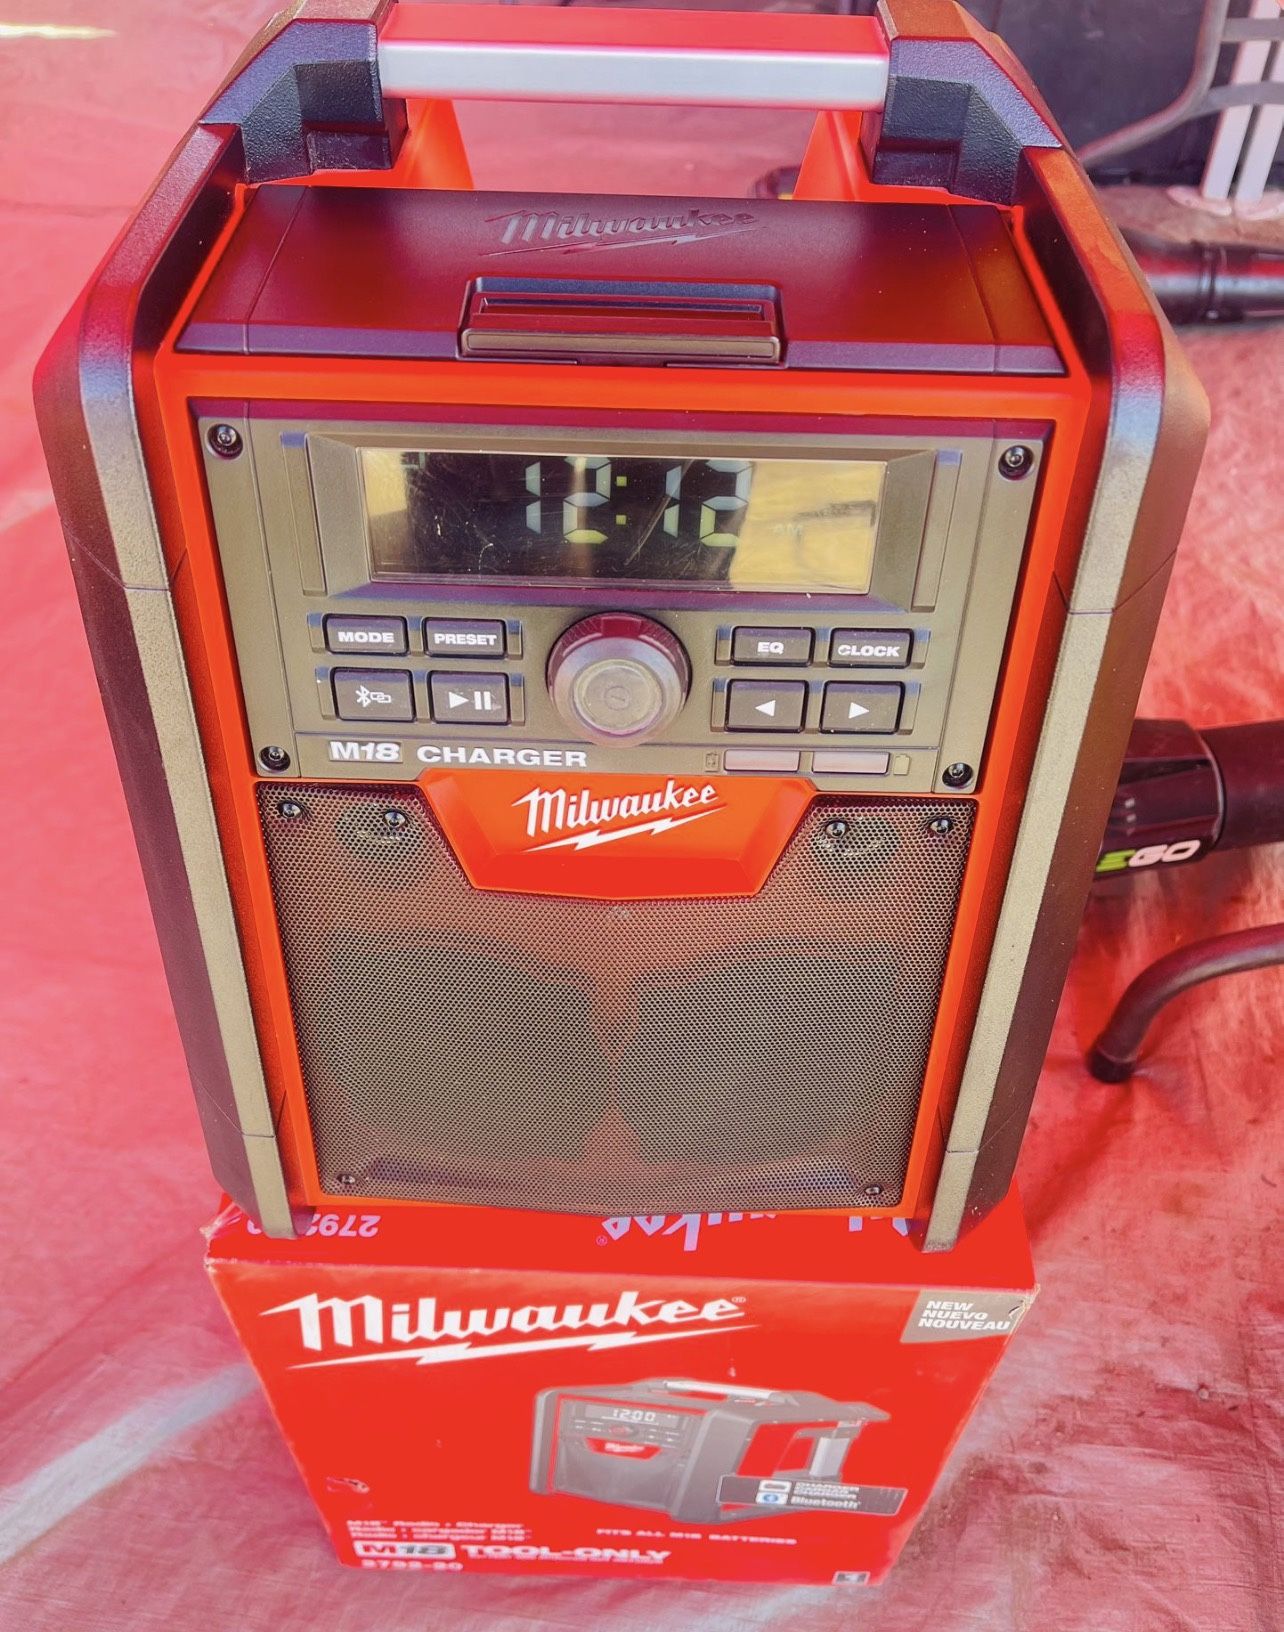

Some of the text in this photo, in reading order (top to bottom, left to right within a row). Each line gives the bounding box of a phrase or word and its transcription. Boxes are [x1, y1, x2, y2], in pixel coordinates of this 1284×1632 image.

[485, 208, 757, 245] Milwaukee
[525, 457, 752, 545] 12:12
[338, 631, 394, 643] MODE
[434, 633, 497, 645] PRESET
[757, 641, 784, 655] EQ
[837, 644, 900, 657] CLOCK
[329, 741, 588, 767] M18 CHARGER
[512, 778, 719, 838] Milwaukee
[1096, 839, 1201, 872] EGO
[926, 1300, 974, 1311] NEW
[259, 1291, 745, 1351] Milwaukee
[922, 1309, 989, 1320] NUEVO
[918, 1318, 1010, 1330] NOUVEAU
[358, 1542, 452, 1557] M18
[461, 1544, 671, 1561] TOOL-ONLY
